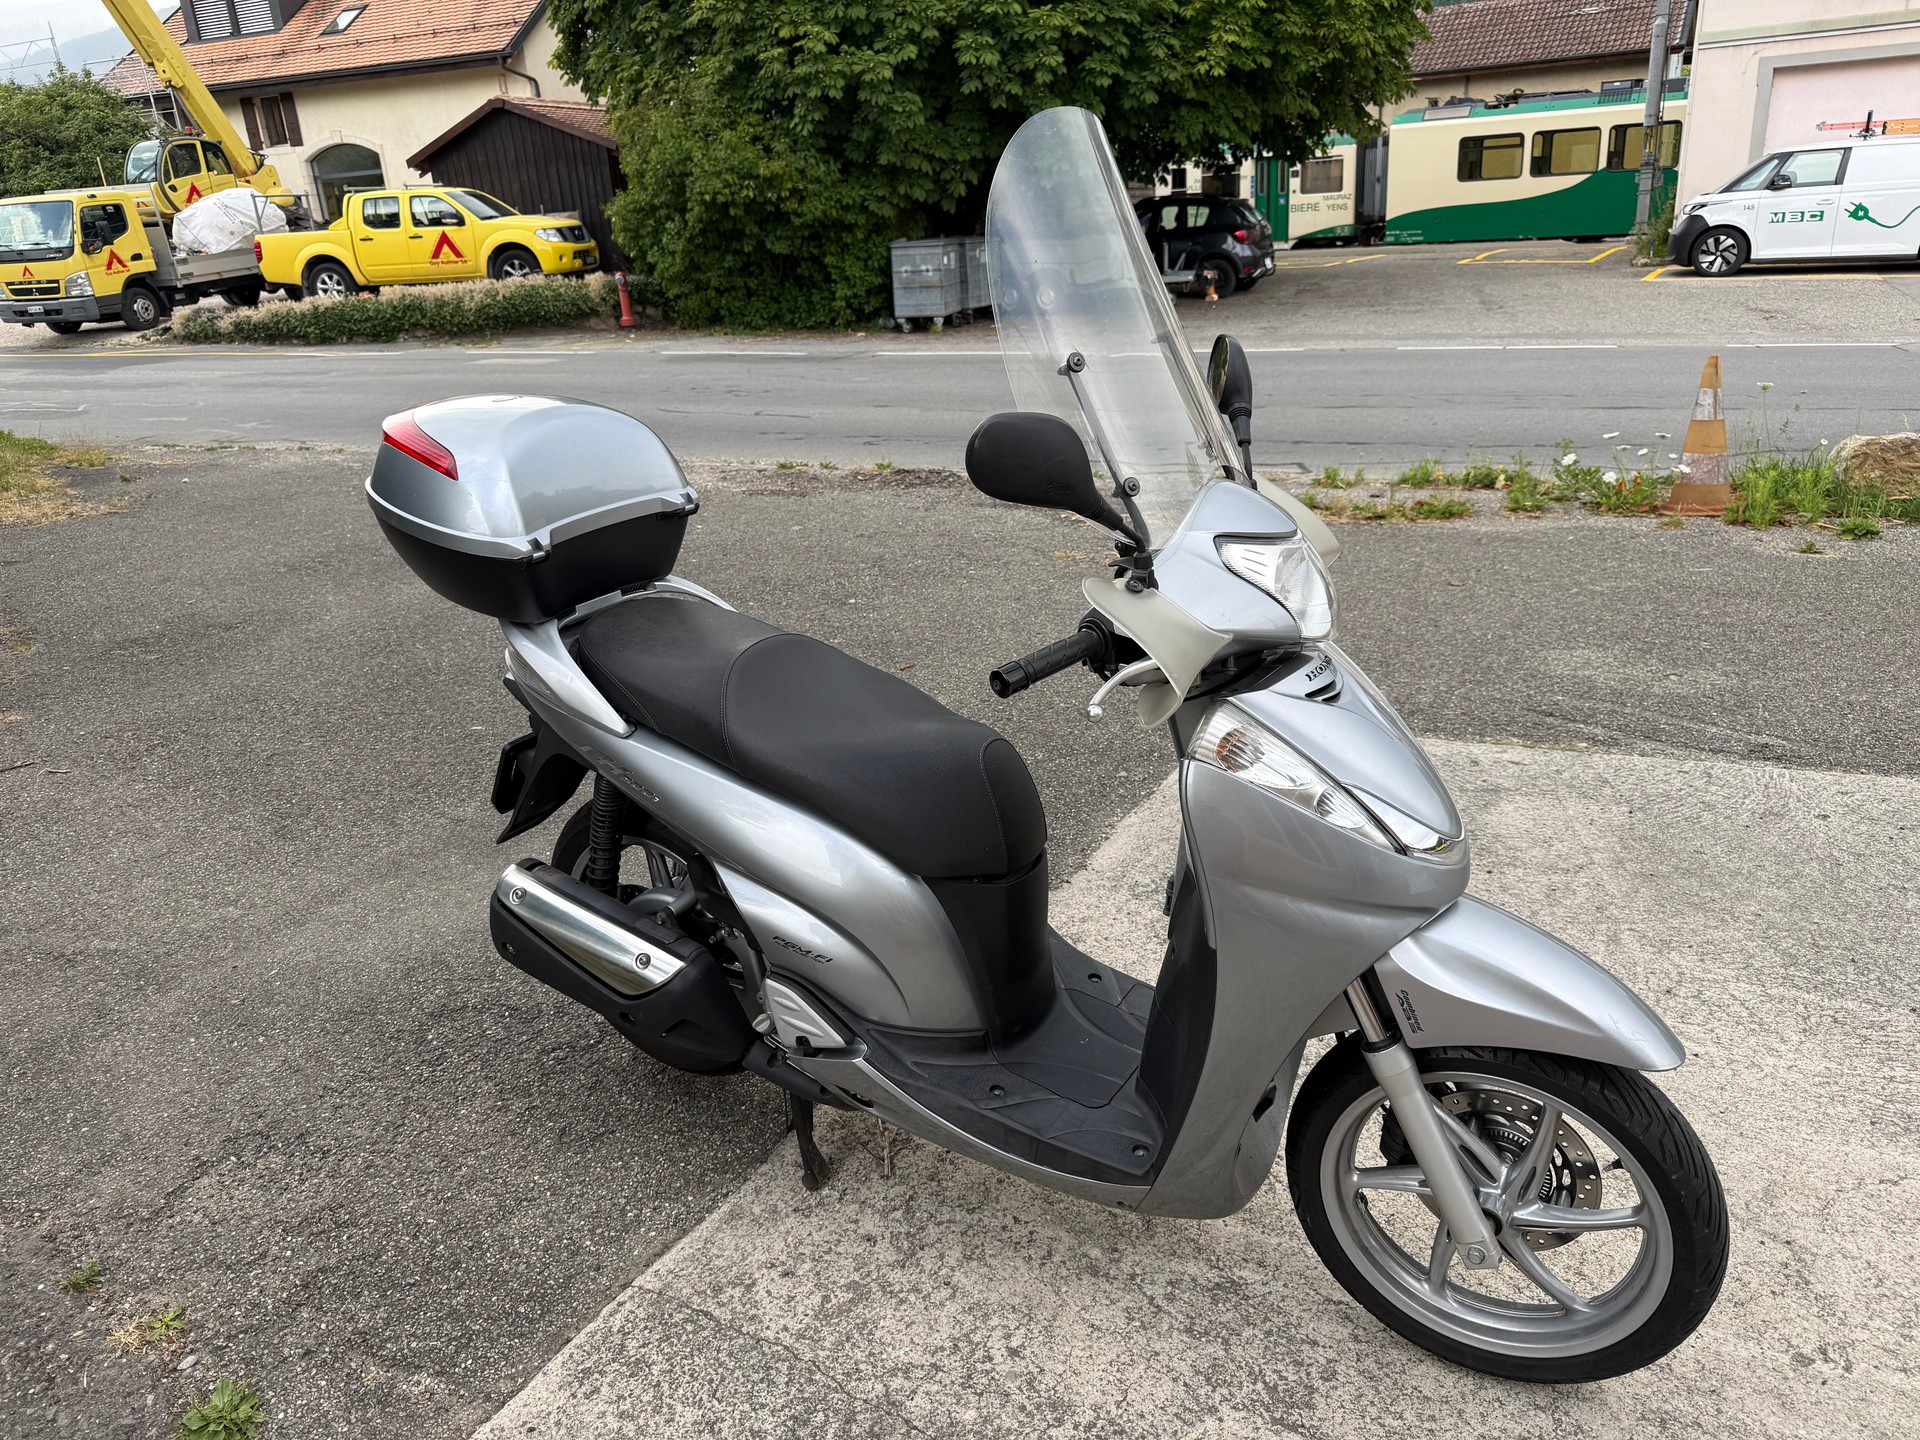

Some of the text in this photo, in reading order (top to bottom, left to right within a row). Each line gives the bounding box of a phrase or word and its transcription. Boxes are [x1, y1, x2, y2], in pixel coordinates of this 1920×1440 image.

[1290, 202, 1320, 213] BIERE
[1326, 203, 1348, 211] YENS
[1768, 210, 1825, 223] MBC
